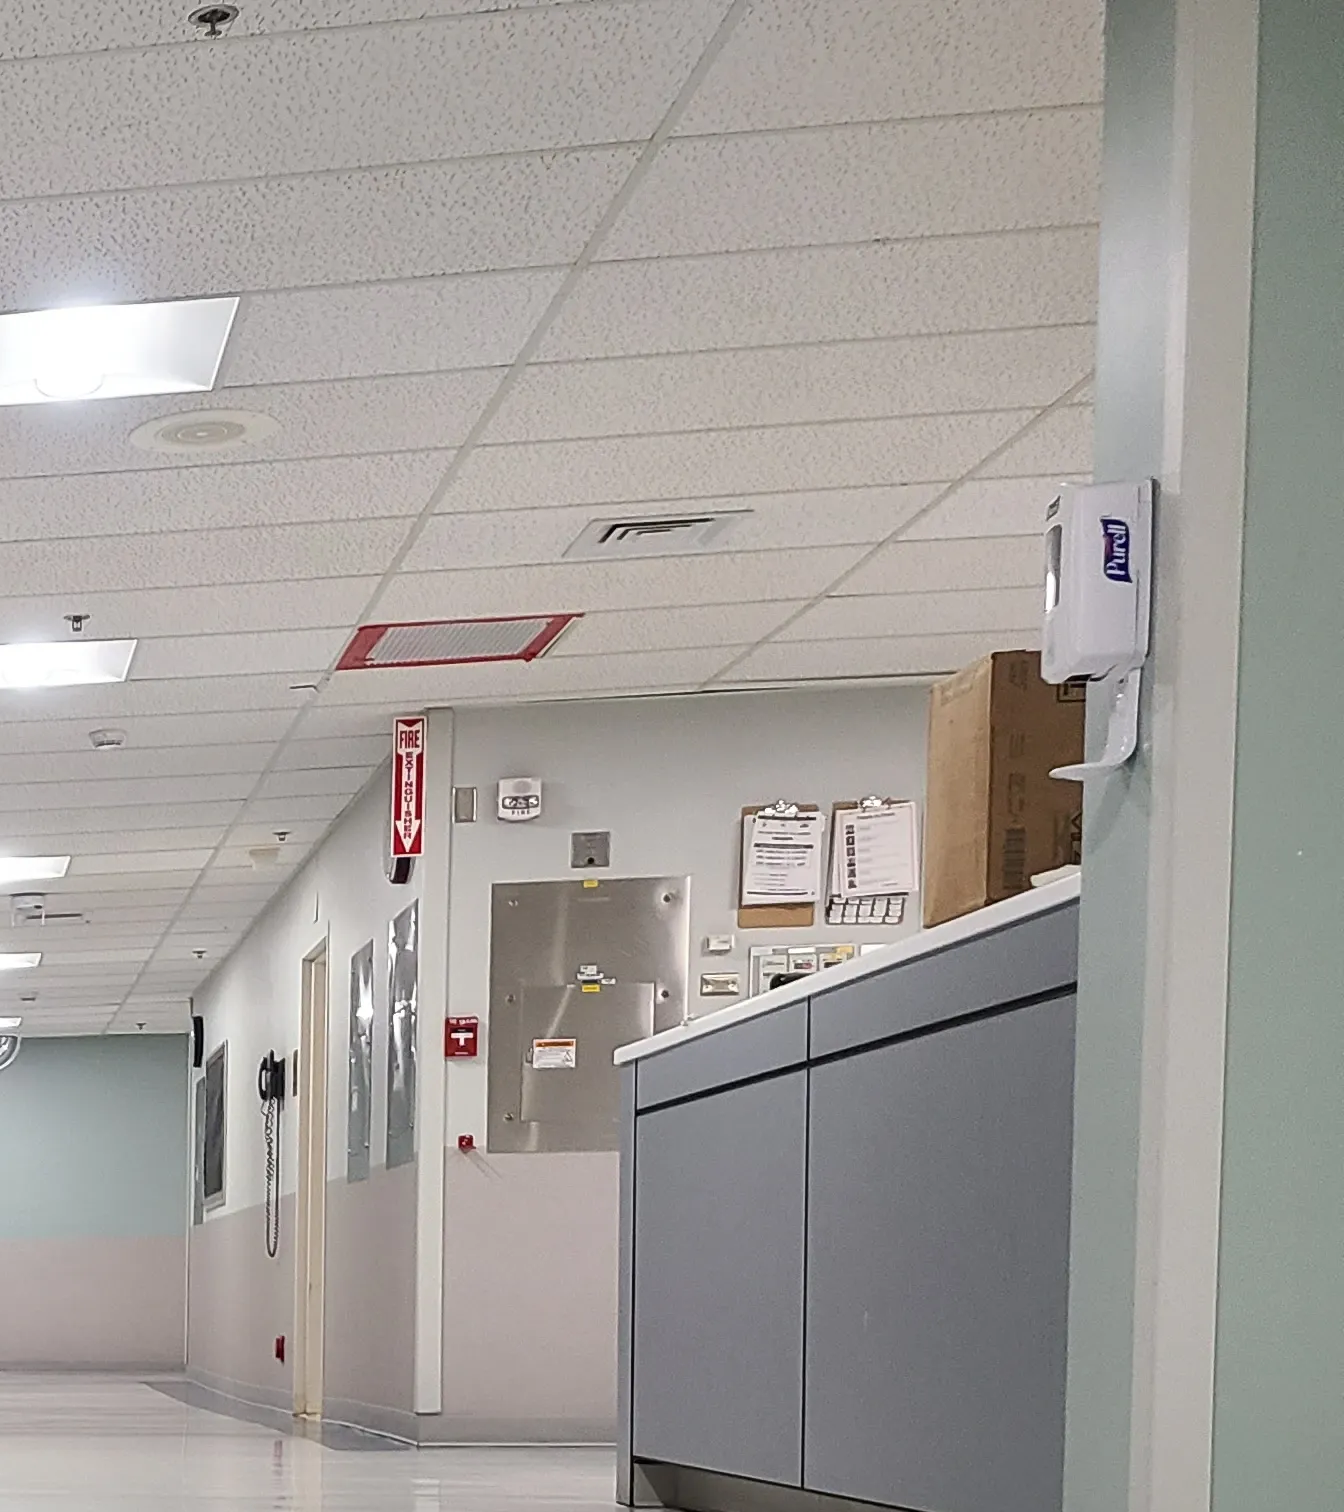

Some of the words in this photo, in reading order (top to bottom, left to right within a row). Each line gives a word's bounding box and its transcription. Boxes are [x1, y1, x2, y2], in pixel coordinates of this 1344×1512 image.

[1106, 523, 1127, 576] Purell
[399, 730, 421, 749] FIRE
[403, 751, 414, 840] EXTINGUISHER
